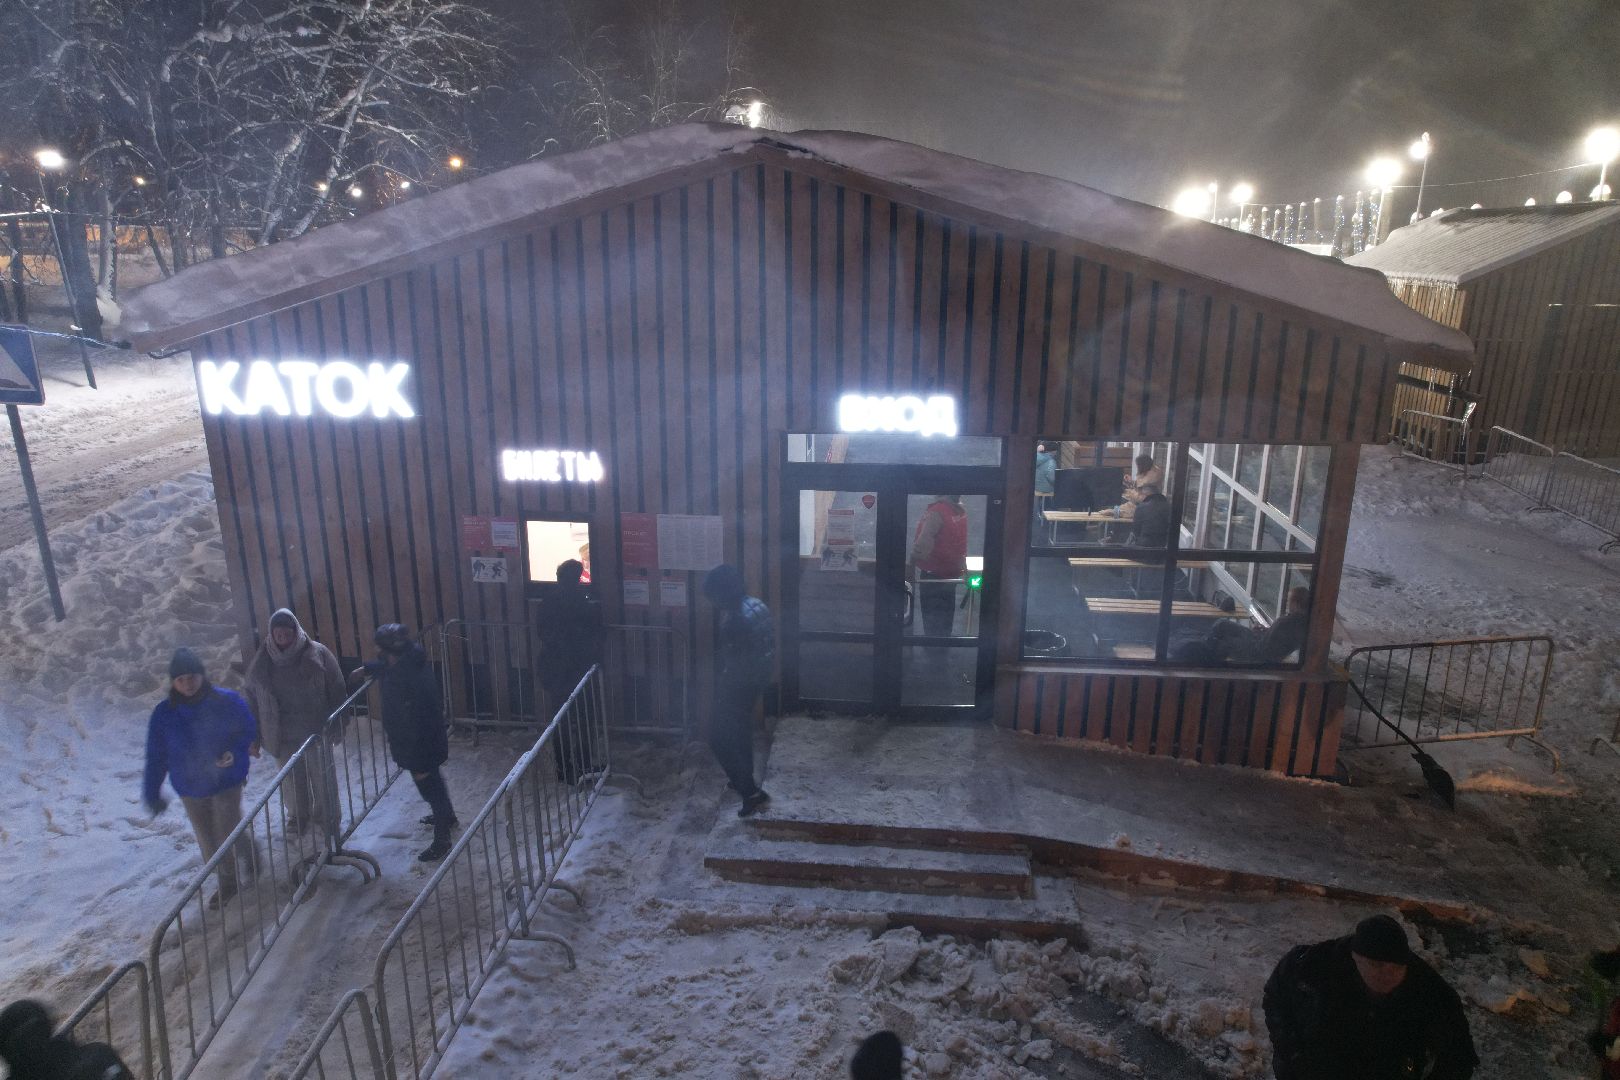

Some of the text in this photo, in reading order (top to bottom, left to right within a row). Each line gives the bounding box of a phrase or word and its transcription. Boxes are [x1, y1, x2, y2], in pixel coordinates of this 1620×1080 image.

[199, 360, 415, 418] КАТОК
[839, 394, 957, 437] ВХОД
[502, 449, 604, 482] БИЛЕТЫ
